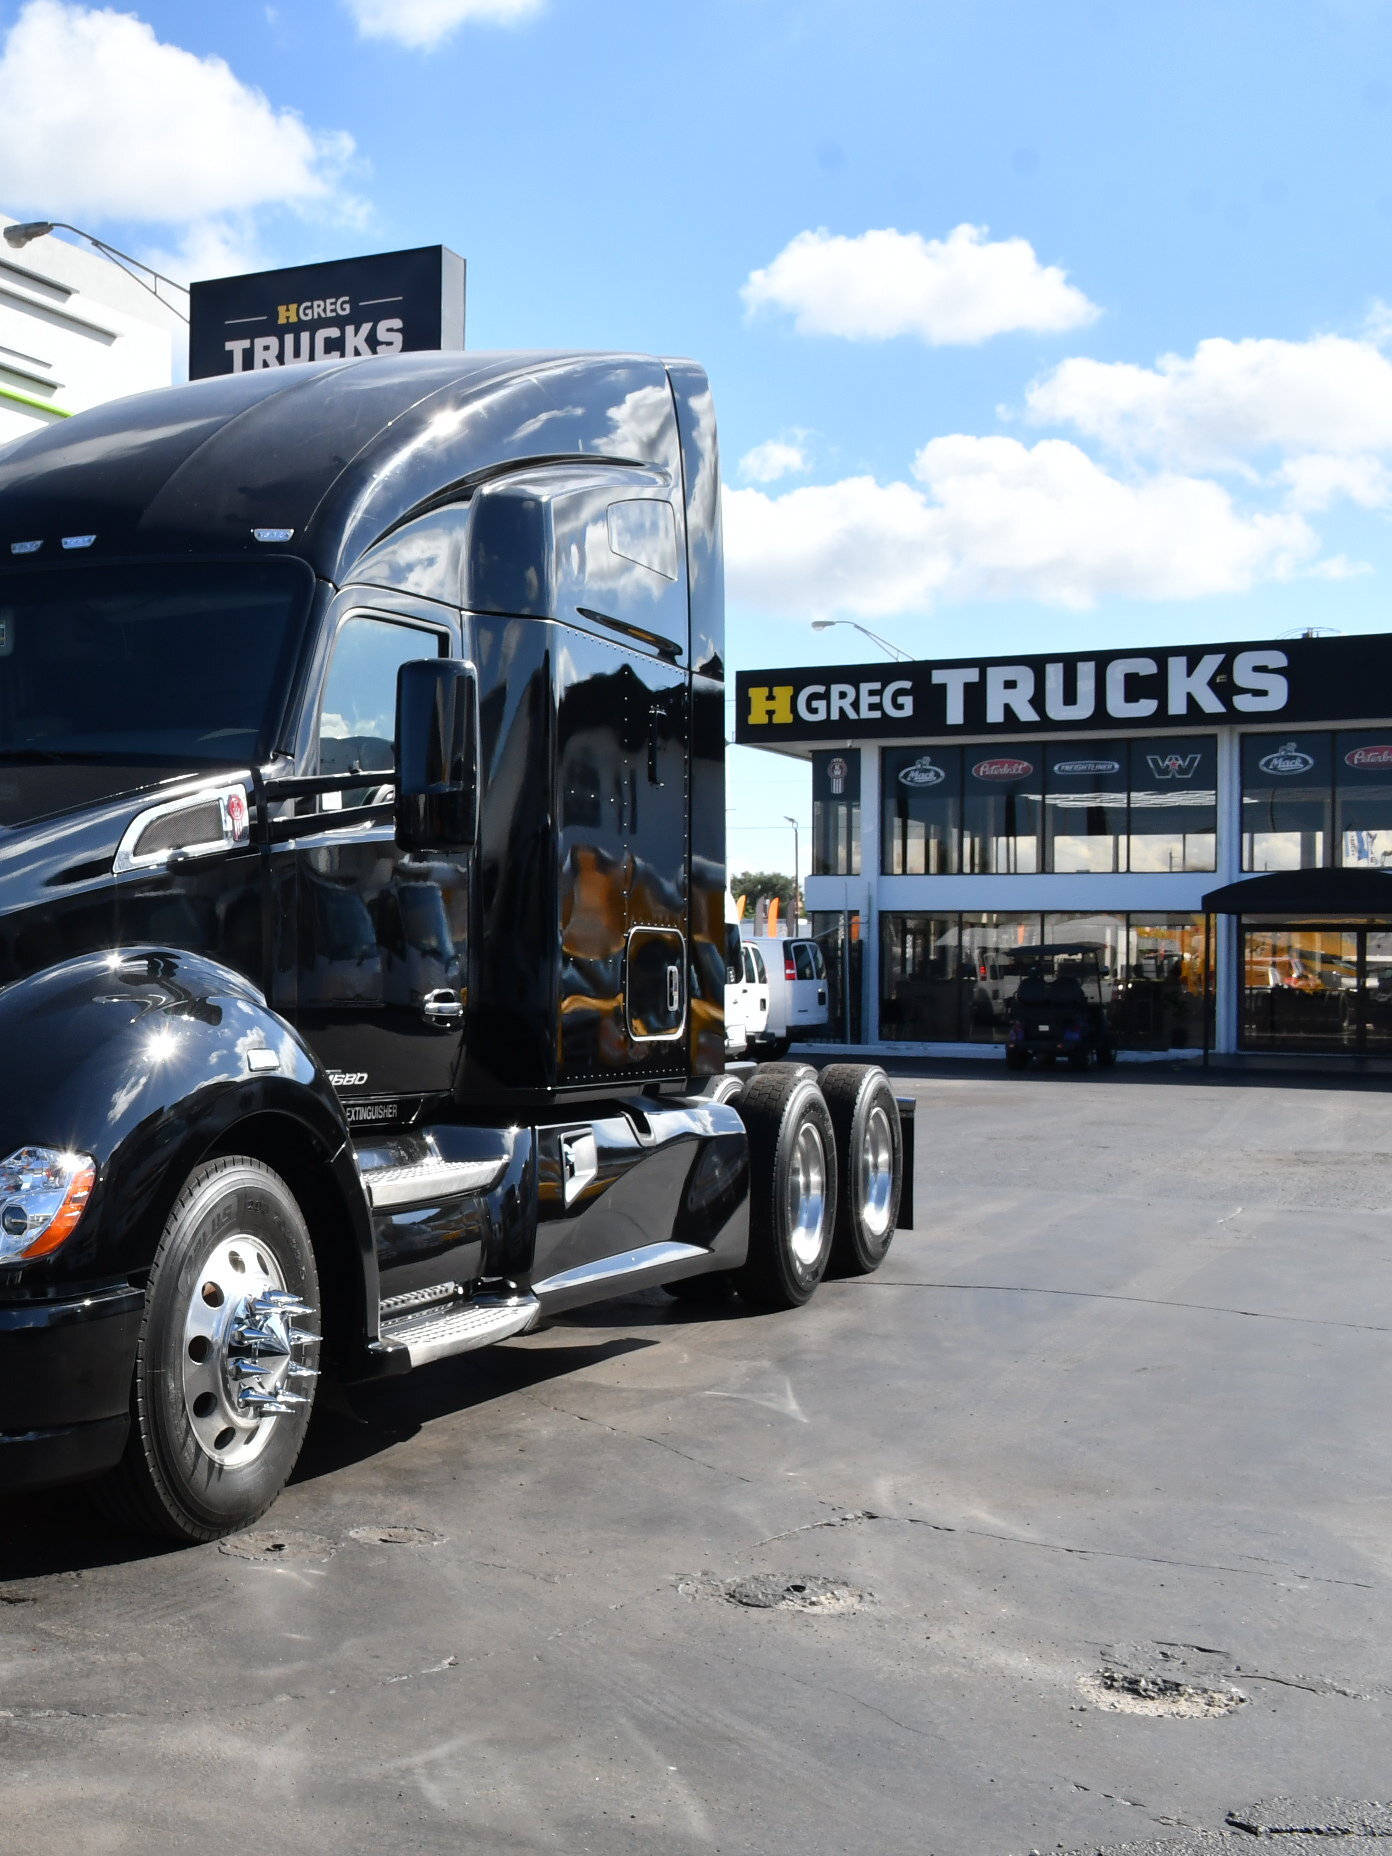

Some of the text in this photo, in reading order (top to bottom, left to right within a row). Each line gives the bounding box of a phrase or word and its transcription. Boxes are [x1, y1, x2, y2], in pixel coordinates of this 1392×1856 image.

[277, 296, 350, 324] HGREG
[224, 317, 404, 373] TRUCKS
[747, 650, 1289, 725] HGREG TRUCKS
[346, 1104, 398, 1122] EXTINGUISHER
